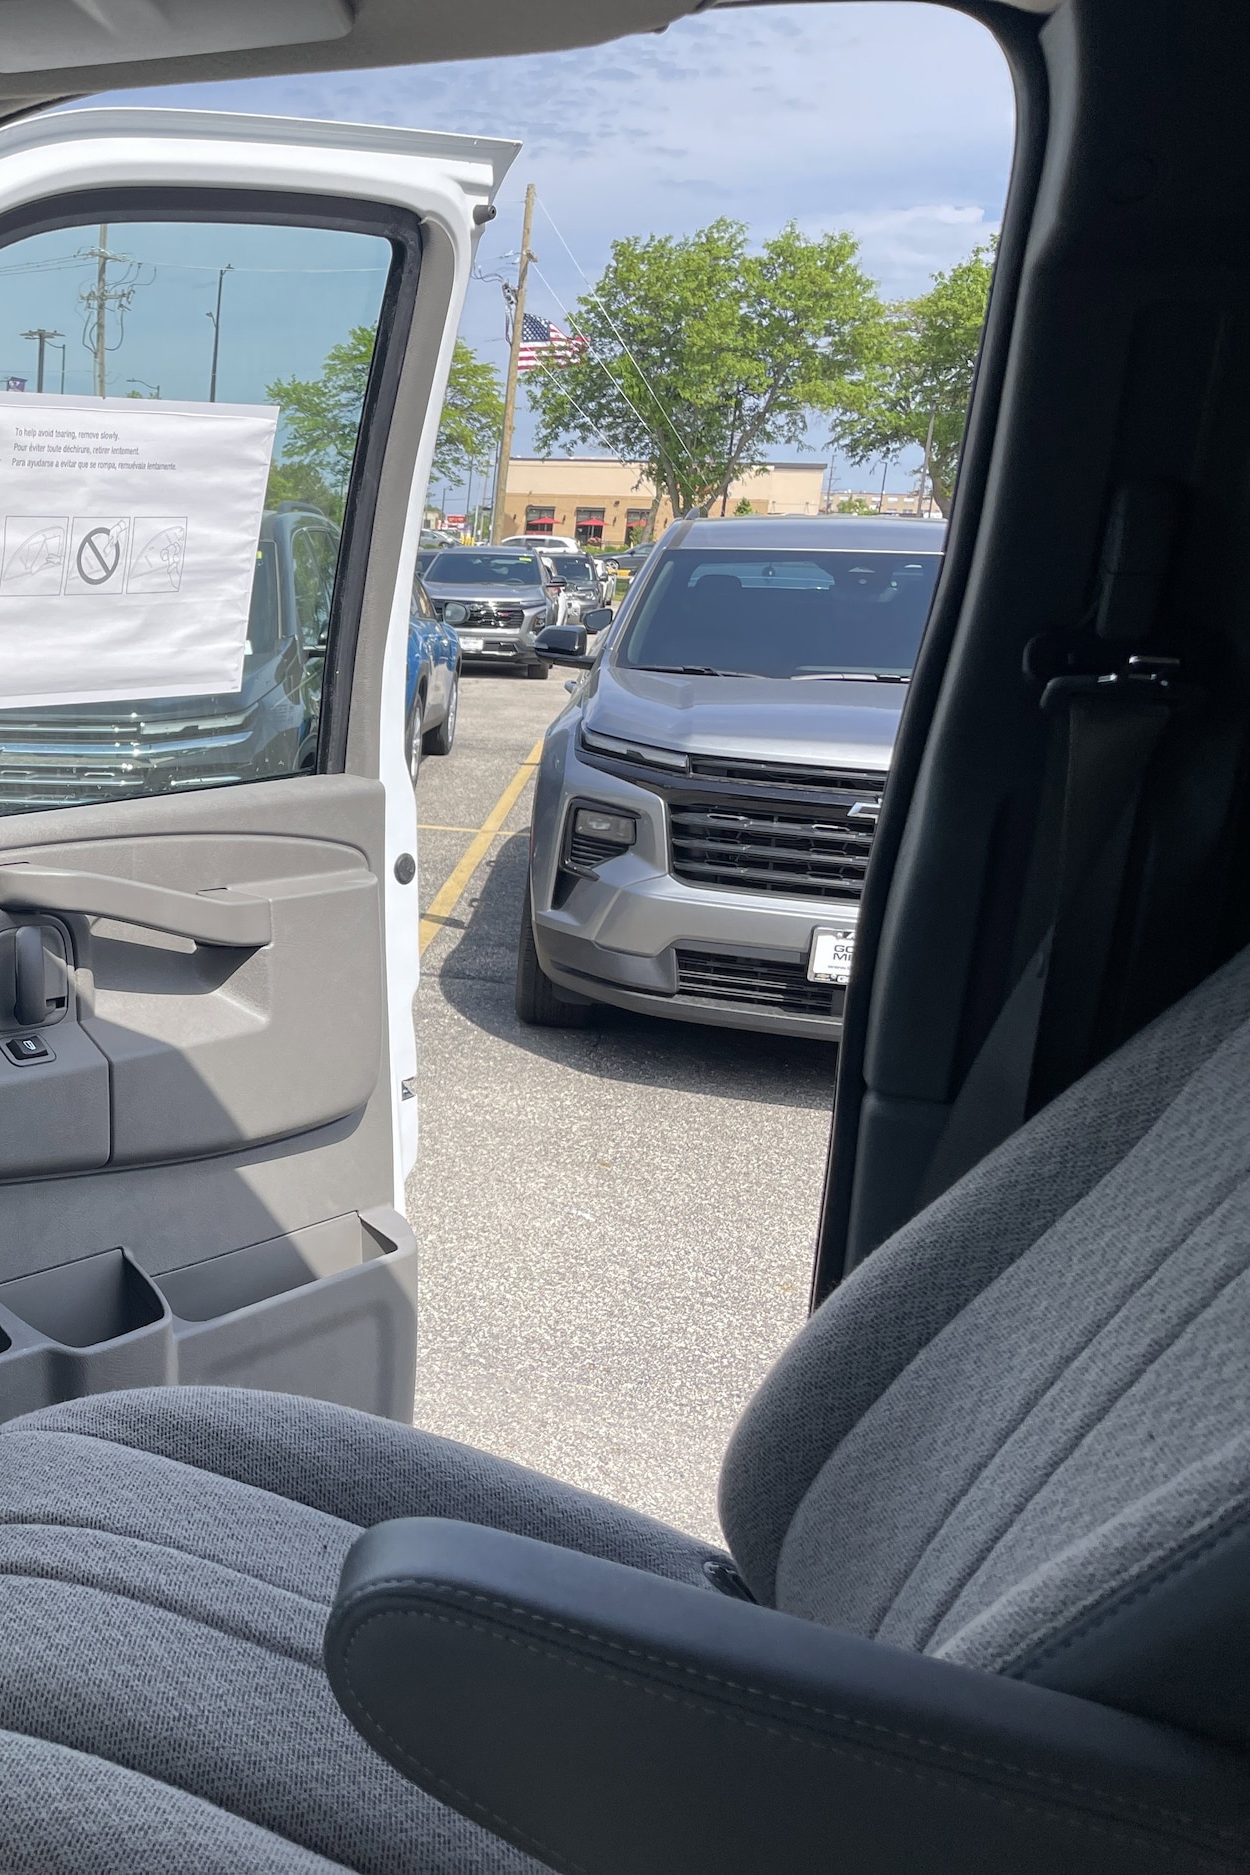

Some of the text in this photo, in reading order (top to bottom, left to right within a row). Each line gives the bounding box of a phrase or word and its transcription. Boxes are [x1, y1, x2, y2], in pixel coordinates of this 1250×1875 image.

[15, 427, 120, 442] To help avoid tearing, remove slowly.
[13, 442, 139, 456] Pour éviter toute déchirure, retirer lentement.
[11, 457, 26, 467] Para
[27, 458, 54, 469] ayudarse
[60, 459, 76, 468] evitar
[78, 461, 89, 470] que
[90, 461, 97, 469] se
[97, 462, 117, 471] rompa,
